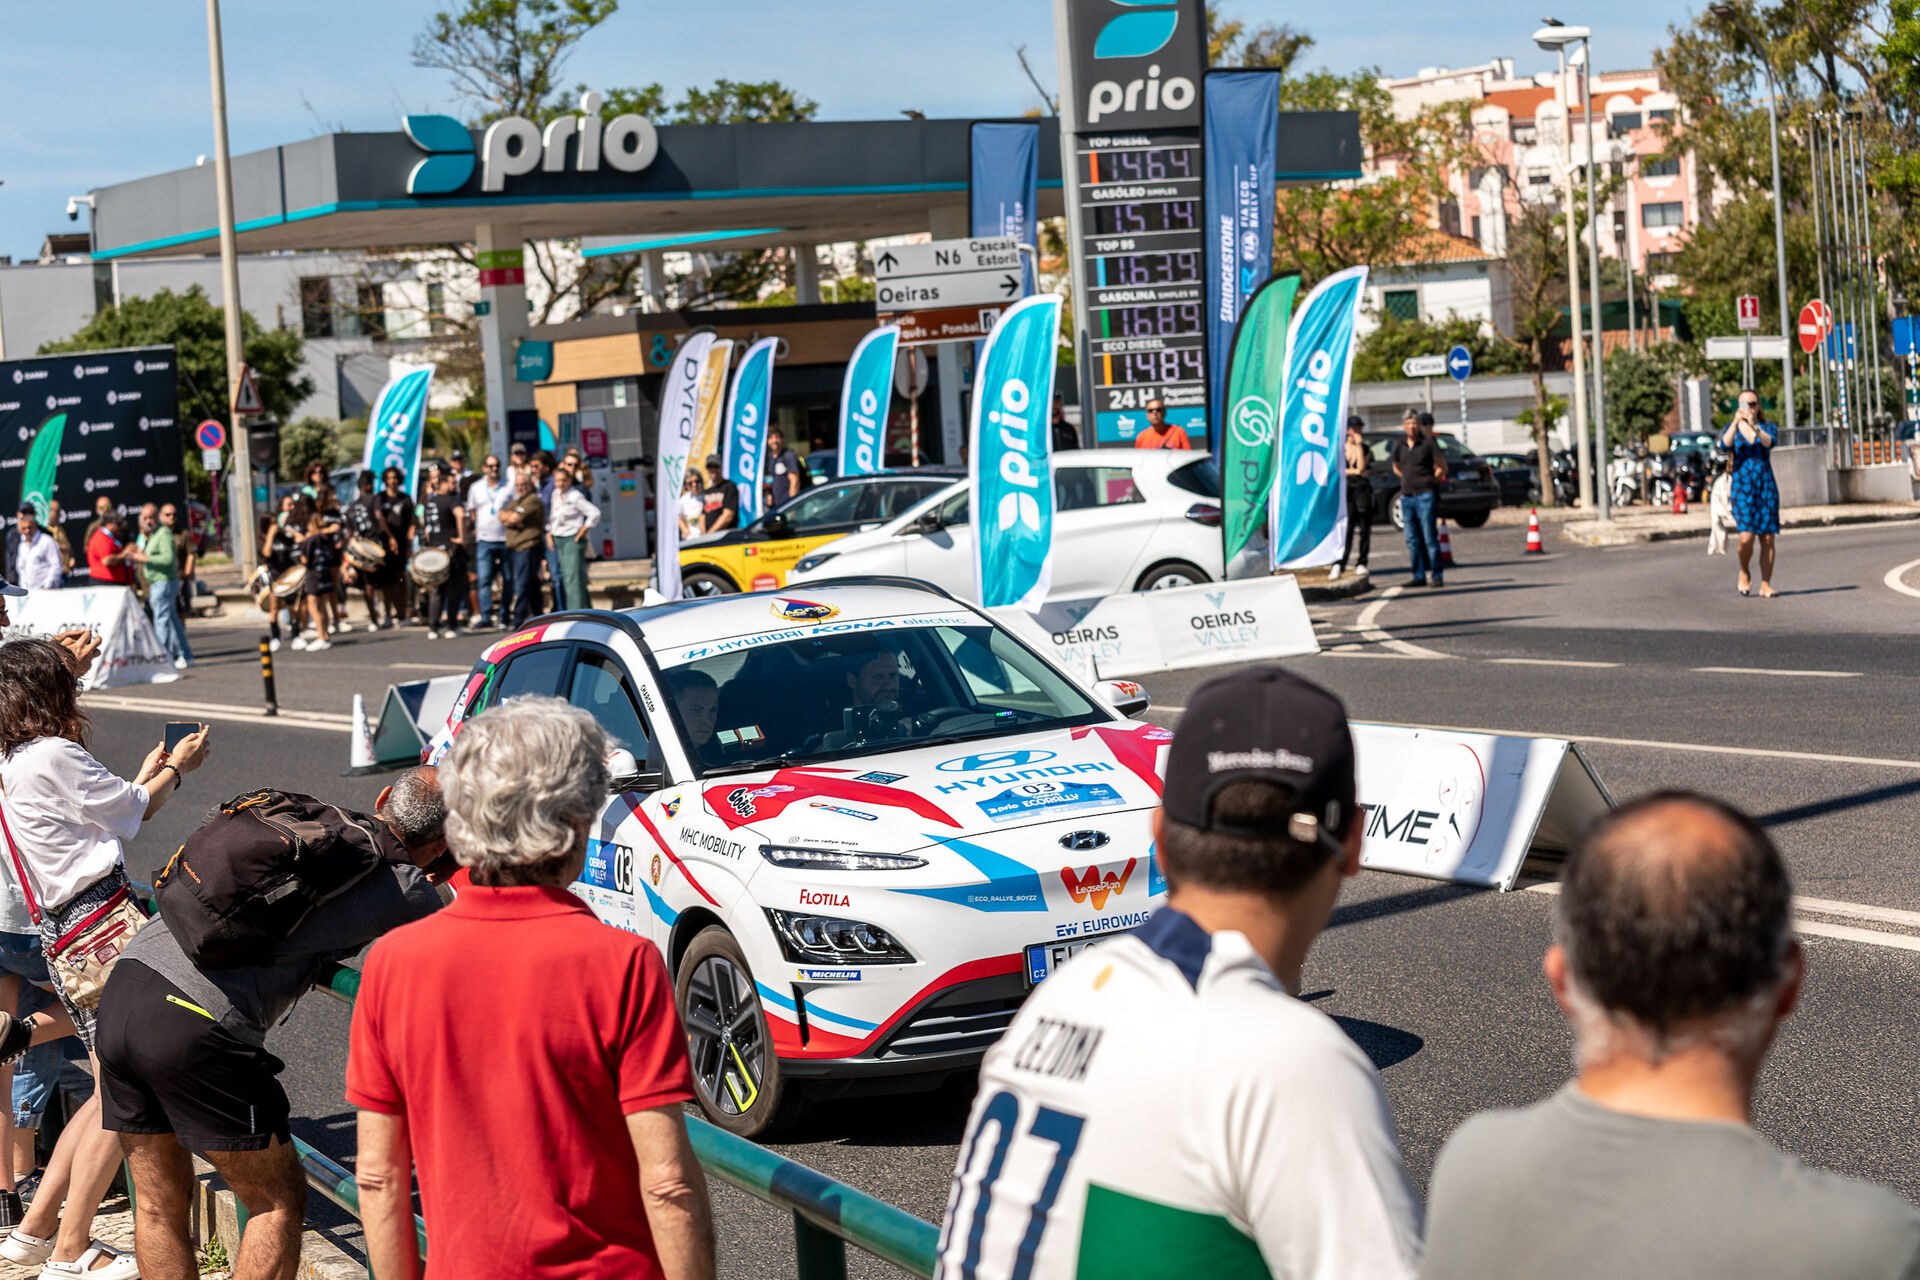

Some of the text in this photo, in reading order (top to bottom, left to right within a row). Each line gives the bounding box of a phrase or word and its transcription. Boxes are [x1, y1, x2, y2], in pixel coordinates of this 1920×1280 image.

[1087, 64, 1196, 124] prio
[481, 91, 659, 192] prio
[1089, 138, 1110, 148] TOP
[969, 240, 1017, 254] Cascais
[1096, 240, 1119, 251] TOP
[977, 253, 1018, 267] Estoril
[1220, 214, 1234, 323] BRIDGESTONE
[879, 286, 940, 304] Oeiras
[1098, 290, 1157, 304] GASOLINA
[1102, 339, 1167, 352] ECO DIESEL
[1108, 389, 1137, 410] 24
[1138, 387, 1155, 408] H
[1296, 349, 1332, 448] prio
[852, 389, 878, 473] prio
[988, 377, 1039, 488] prio
[736, 402, 758, 482] prio
[1191, 611, 1257, 630] OEIRAS
[717, 616, 968, 652] HYUNDAI KONA electric
[1051, 625, 1120, 646] OEIRAS
[1194, 626, 1260, 647] VALLEY
[934, 762, 1116, 795] HYUNDAI
[1022, 782, 1057, 795] 03
[1021, 793, 1080, 808] ECORALLY
[679, 826, 747, 861] MHC MOBILITY
[613, 846, 633, 894] 03
[799, 888, 851, 908] FLOTILA
[1075, 880, 1121, 895] LeasePlan
[1082, 911, 1150, 933] EUROWAG
[811, 971, 858, 979] MICHELIN
[1033, 969, 1046, 979] CZ
